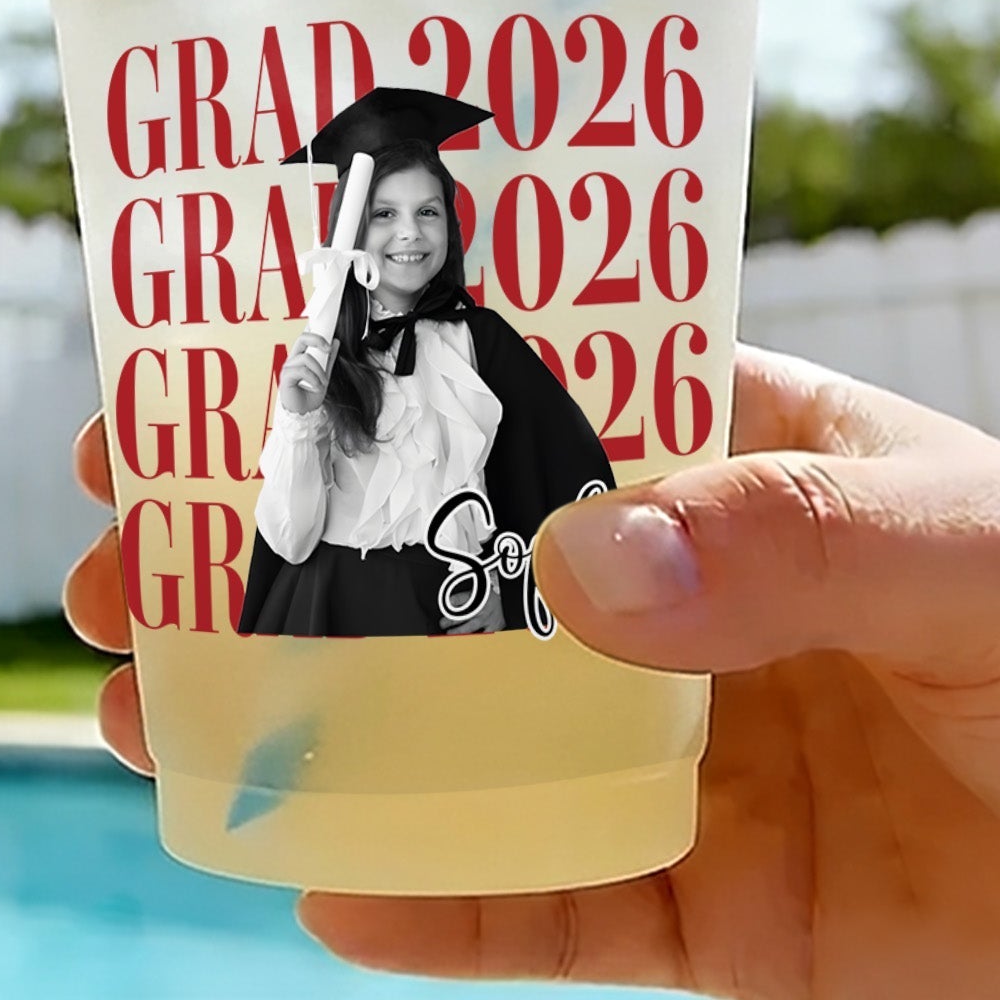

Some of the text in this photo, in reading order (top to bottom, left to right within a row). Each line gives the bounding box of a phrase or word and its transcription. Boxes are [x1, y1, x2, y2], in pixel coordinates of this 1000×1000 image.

[107, 14, 704, 180] GRAD 2026
[111, 183, 340, 329] GRA
[526, 322, 714, 463] 26
[121, 499, 253, 637] GR
